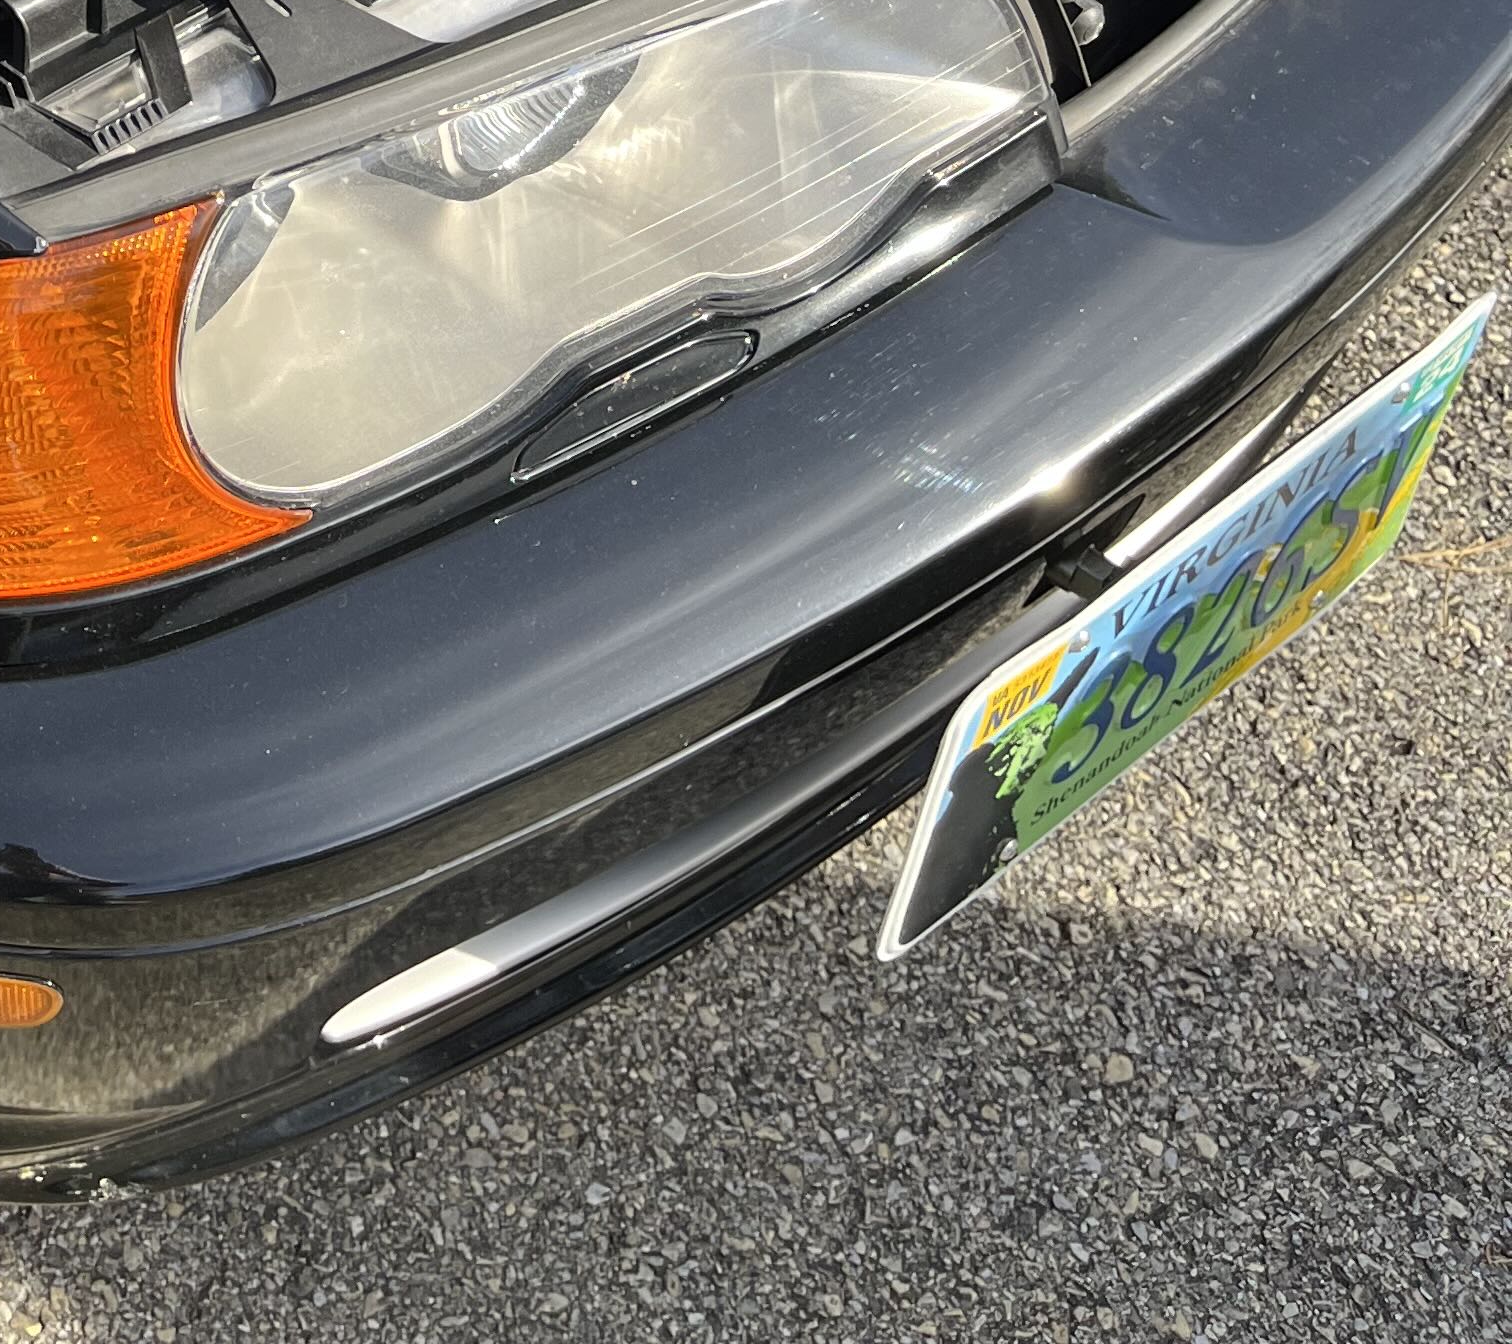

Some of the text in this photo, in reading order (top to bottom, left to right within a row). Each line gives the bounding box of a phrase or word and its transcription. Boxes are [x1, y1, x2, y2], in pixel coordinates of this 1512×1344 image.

[1112, 428, 1359, 639] VIRGINIA
[982, 668, 1053, 738] NOV
[1031, 600, 1302, 826] Shenandoah National Park
